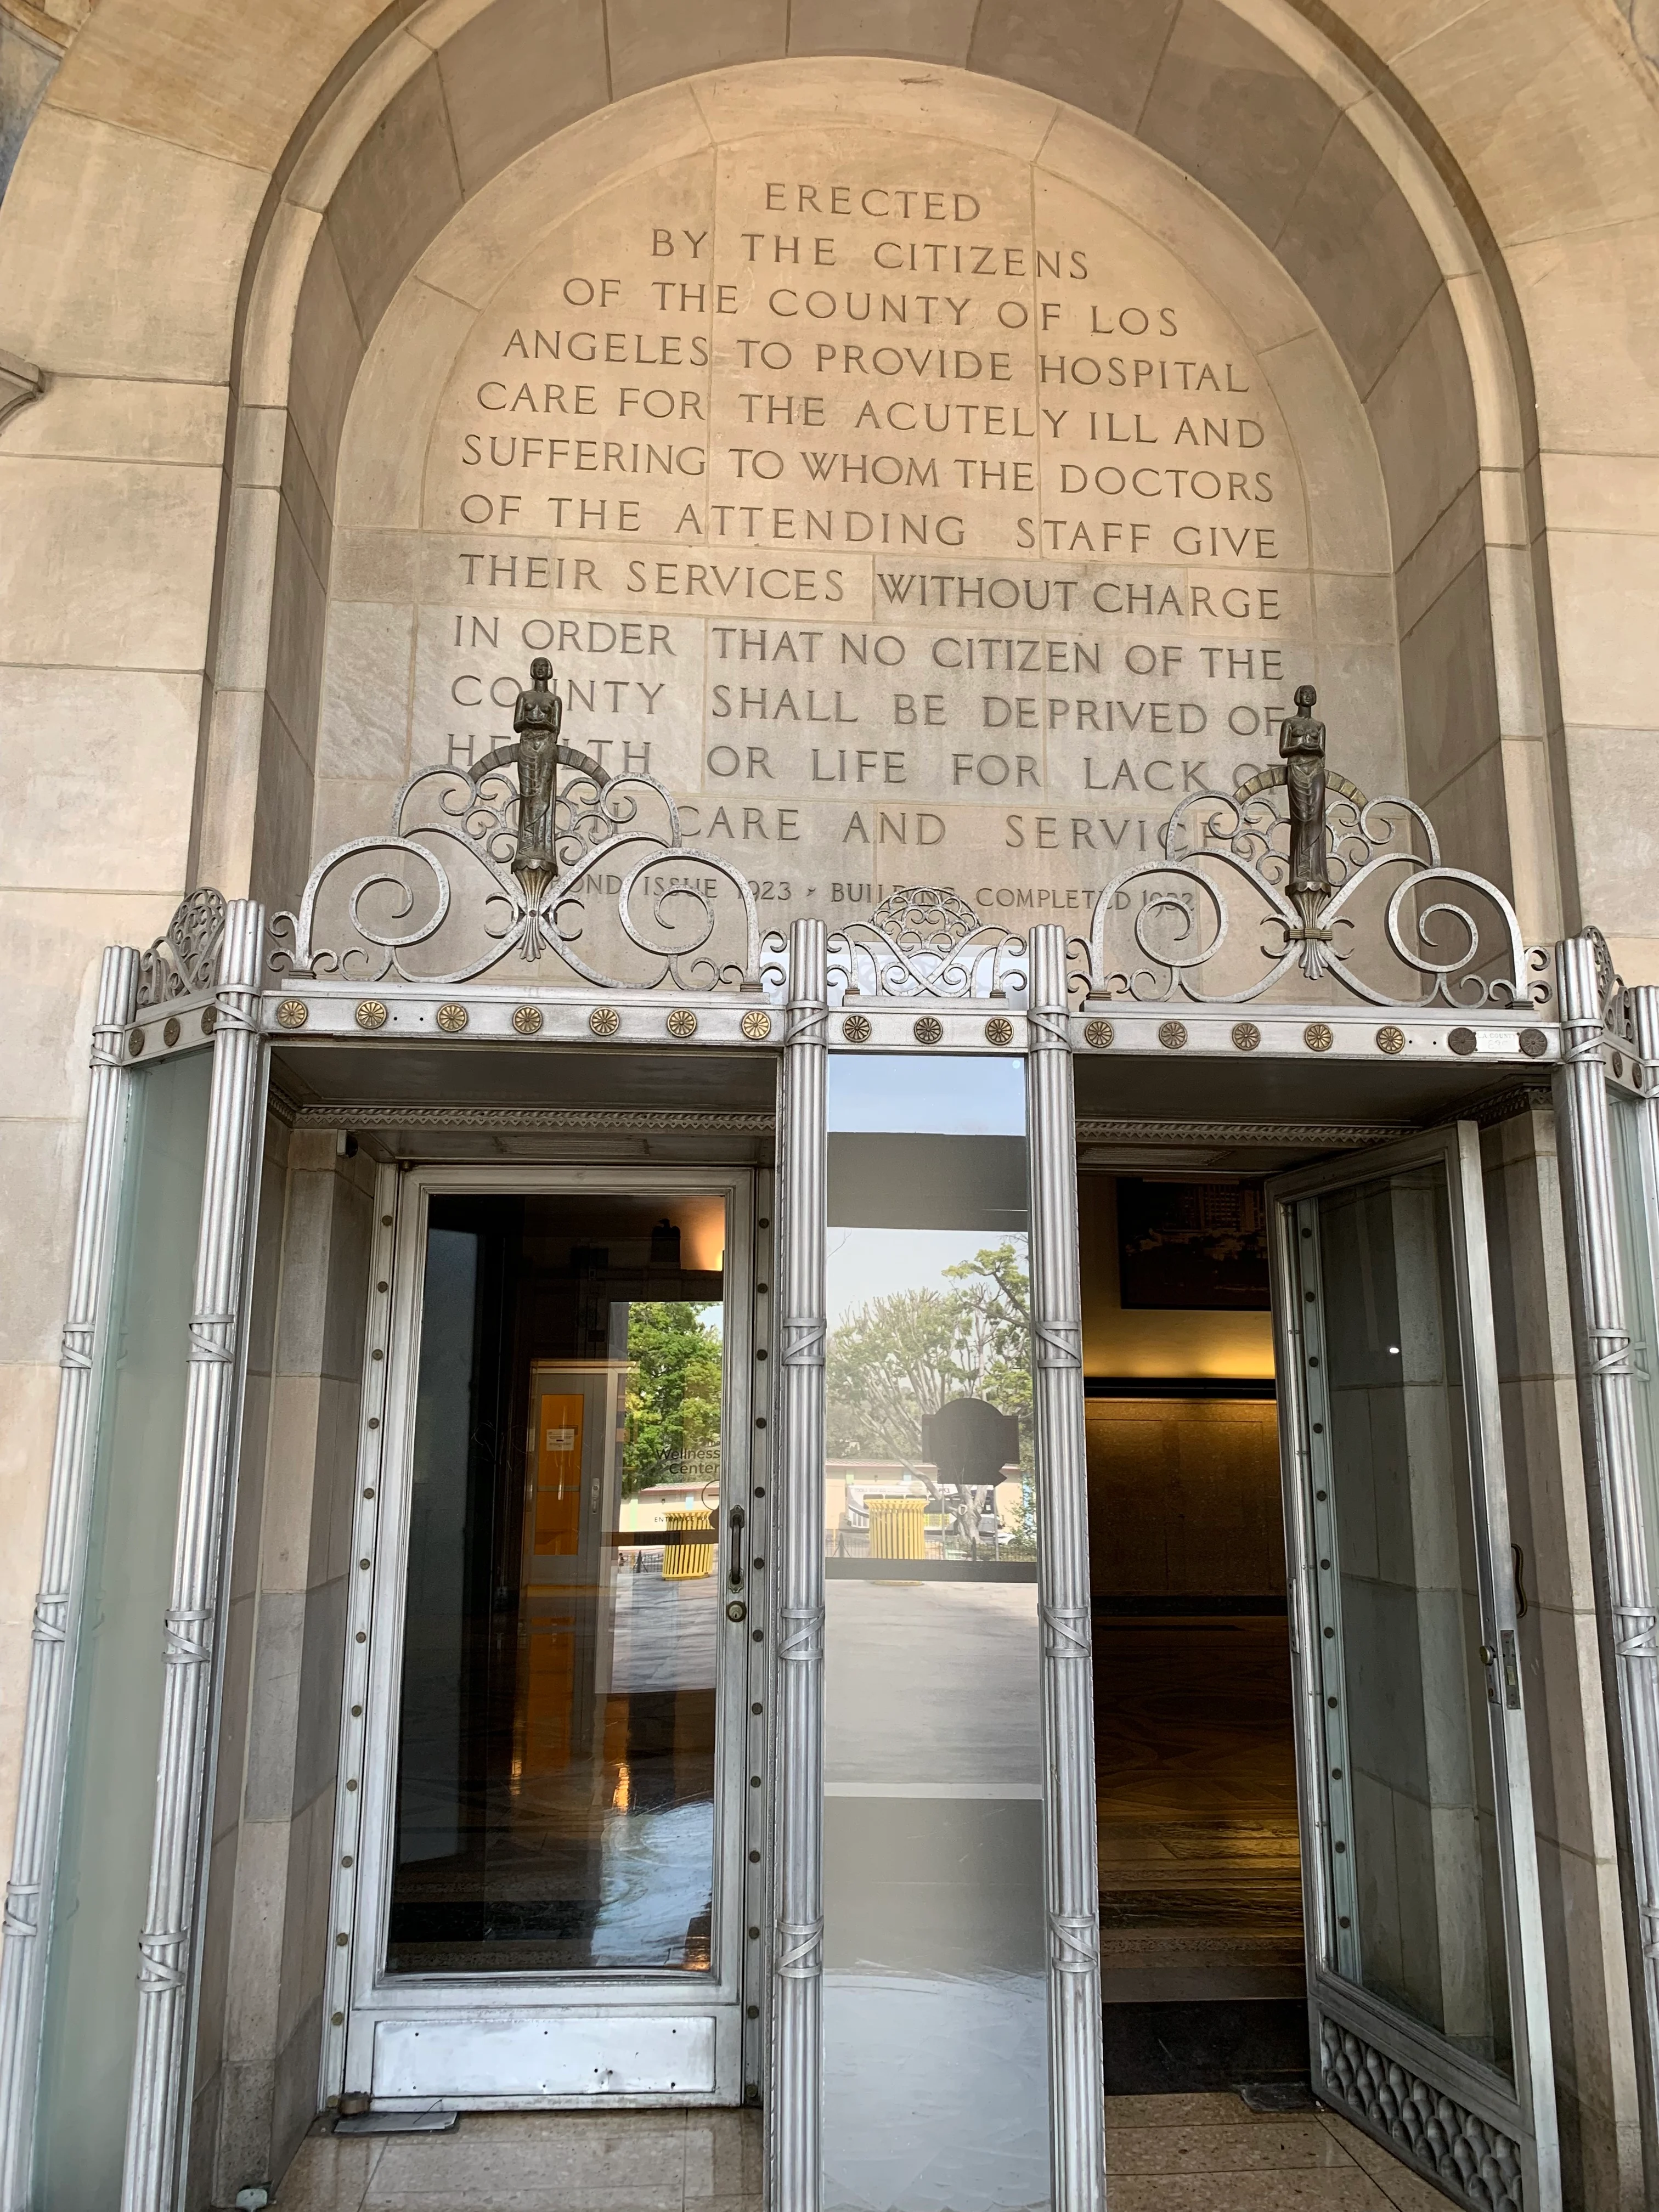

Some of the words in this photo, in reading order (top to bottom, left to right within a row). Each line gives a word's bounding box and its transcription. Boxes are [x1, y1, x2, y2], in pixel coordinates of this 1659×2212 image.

[765, 182, 981, 222] ERECTED
[651, 228, 708, 259] BY
[740, 233, 837, 266] THE
[873, 242, 1088, 280] CITIZENS
[563, 278, 621, 307] OF
[651, 281, 738, 314] THE
[769, 289, 972, 326] COUNTY
[997, 301, 1061, 331] OF
[1090, 305, 1178, 336] LOS
[502, 329, 709, 366] ANGELES
[736, 340, 792, 370] TO
[816, 343, 1012, 381] PROVIDE
[1039, 355, 1250, 393] HOSPITAL
[477, 381, 597, 415] CARE
[618, 387, 706, 421] FOR
[738, 394, 826, 427] THE
[854, 399, 1069, 438] ACUTELY
[1088, 411, 1158, 443] ILL
[1173, 416, 1265, 448] AND
[461, 434, 706, 476] SUFFERING
[729, 448, 783, 479] TO
[800, 452, 940, 488] WHOM
[953, 459, 1035, 492] THE
[1060, 464, 1273, 503] DOCTORS
[460, 494, 522, 525] OF
[548, 497, 641, 532] THE
[674, 503, 965, 545] ATTENDING
[1016, 517, 1150, 553] STAFF
[1173, 526, 1279, 559] GIVE
[458, 554, 603, 591] THEIR
[627, 560, 844, 602] SERVICES
[877, 573, 1079, 612] WITHOUT
[1093, 583, 1282, 620] CHARGE
[453, 615, 500, 648] IN
[522, 619, 677, 657] ORDER
[712, 627, 823, 664] THAT
[840, 633, 906, 666] NO
[933, 637, 1101, 674] CITIZEN
[1125, 645, 1183, 677] OF
[1199, 647, 1285, 681] THE
[712, 685, 859, 723] SHALL
[893, 693, 947, 726] BE
[982, 696, 1207, 735] DEPRIVED
[1227, 706, 1285, 737] OF
[446, 733, 651, 775] HELTH
[707, 745, 775, 779] OR
[811, 748, 907, 785] LIFE
[952, 753, 1041, 788] FOR
[1084, 757, 1212, 792] LACK
[675, 805, 800, 842] CARE
[842, 810, 946, 846] AND
[644, 876, 718, 899] ISSUE
[831, 882, 956, 905] BUILDNG
[976, 888, 1131, 911] COMPLETD
[656, 1447, 720, 1460] Wellness
[669, 1463, 720, 1475] Center
